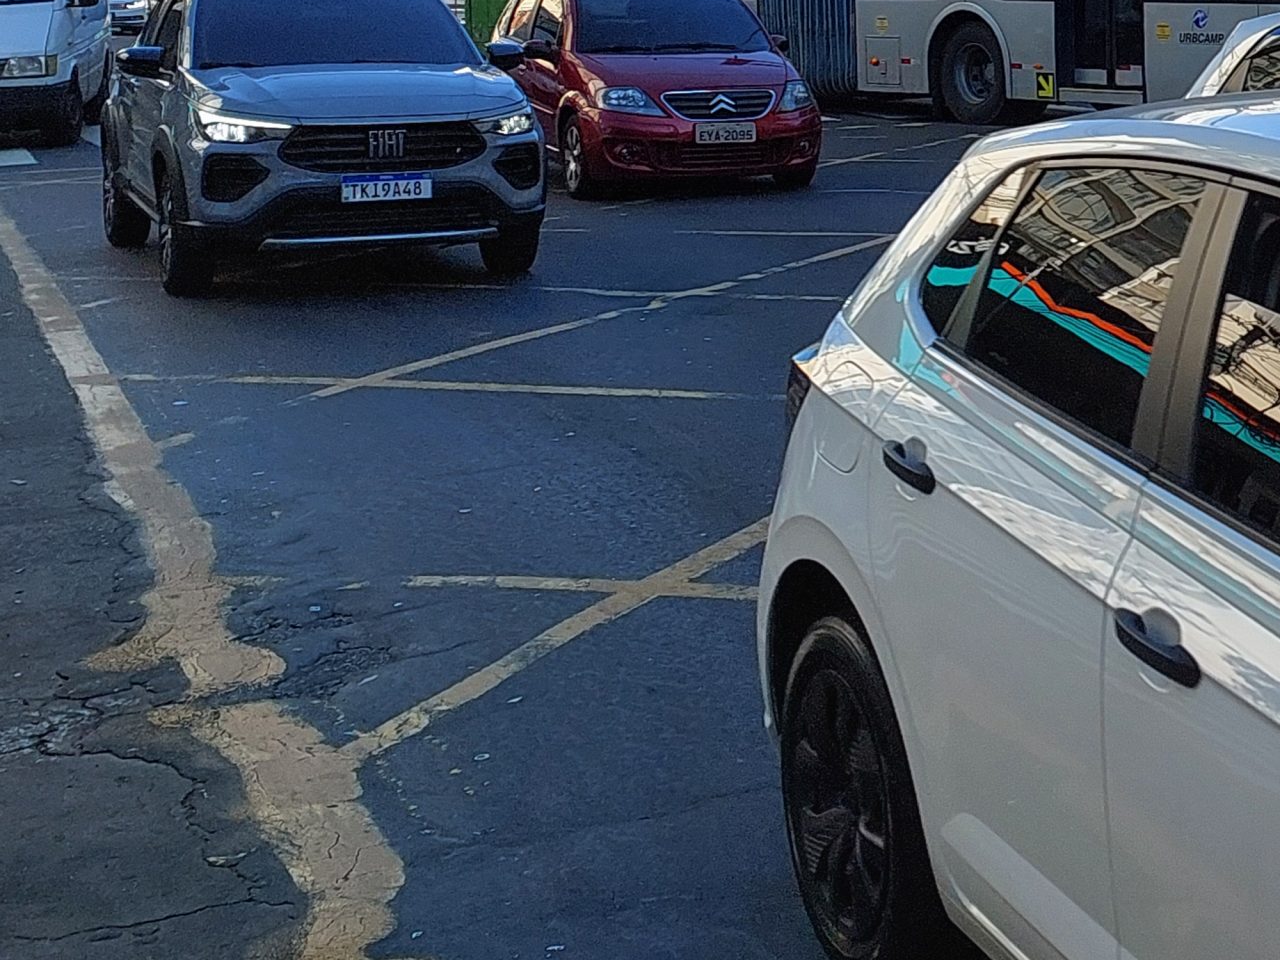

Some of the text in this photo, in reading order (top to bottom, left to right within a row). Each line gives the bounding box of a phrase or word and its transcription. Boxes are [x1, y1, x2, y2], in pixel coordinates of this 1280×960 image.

[1179, 32, 1224, 44] URBCAMP
[699, 129, 754, 141] EYA-2095
[368, 129, 407, 158] FIAT
[350, 181, 422, 199] TKI9A48
